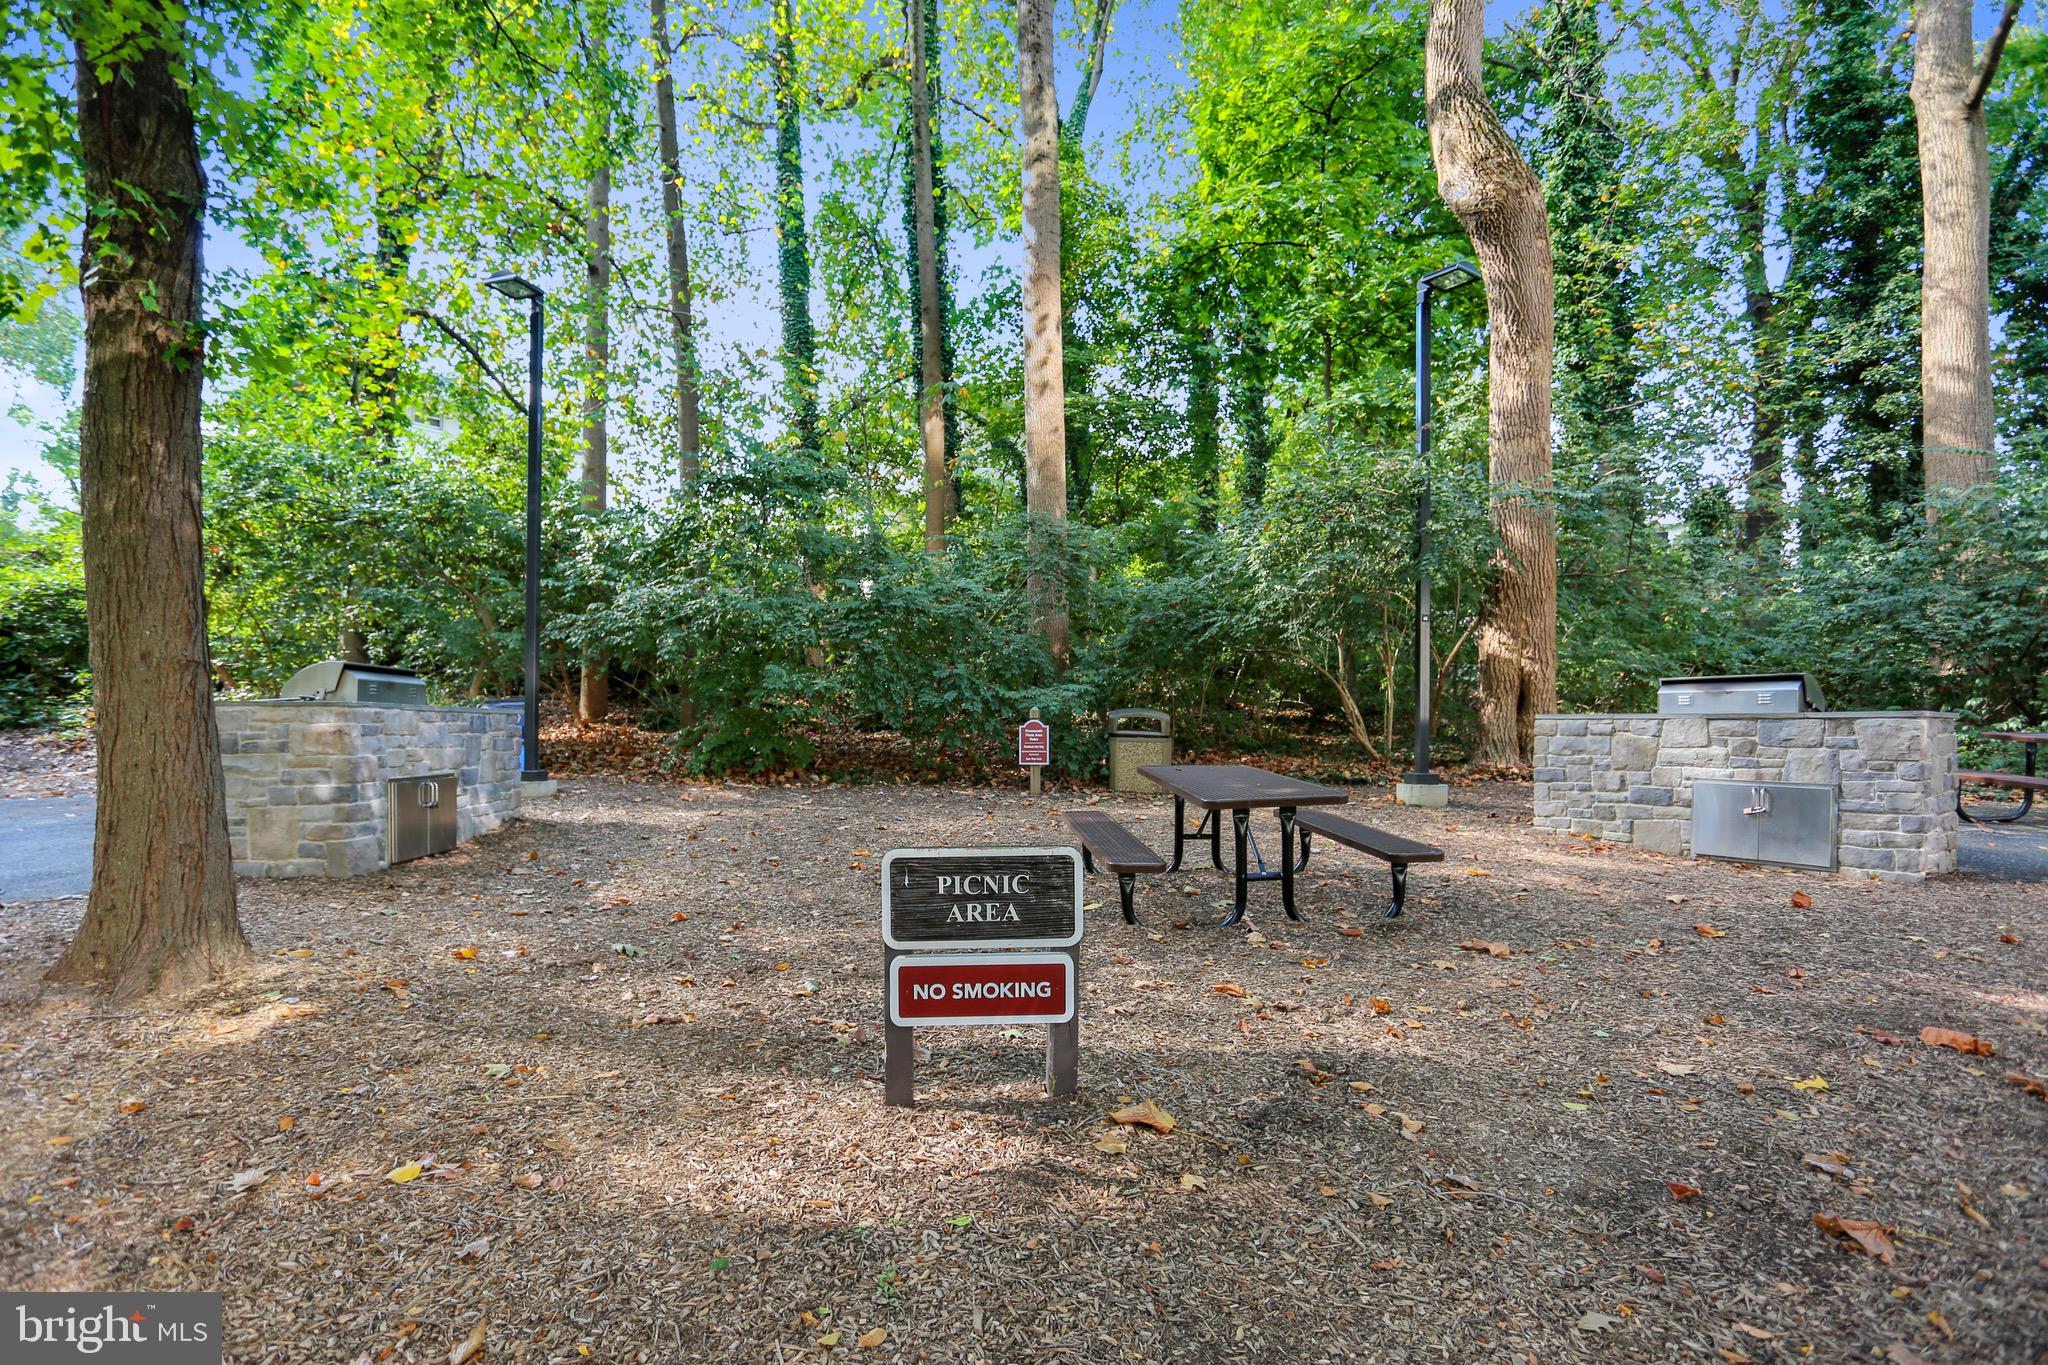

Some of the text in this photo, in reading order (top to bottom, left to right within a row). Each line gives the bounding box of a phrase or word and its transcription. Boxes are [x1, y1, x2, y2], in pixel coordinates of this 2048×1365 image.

[936, 874, 1030, 895] PICNIC
[946, 903, 1021, 923] AREA
[913, 981, 1051, 1000] NO SMOKING
